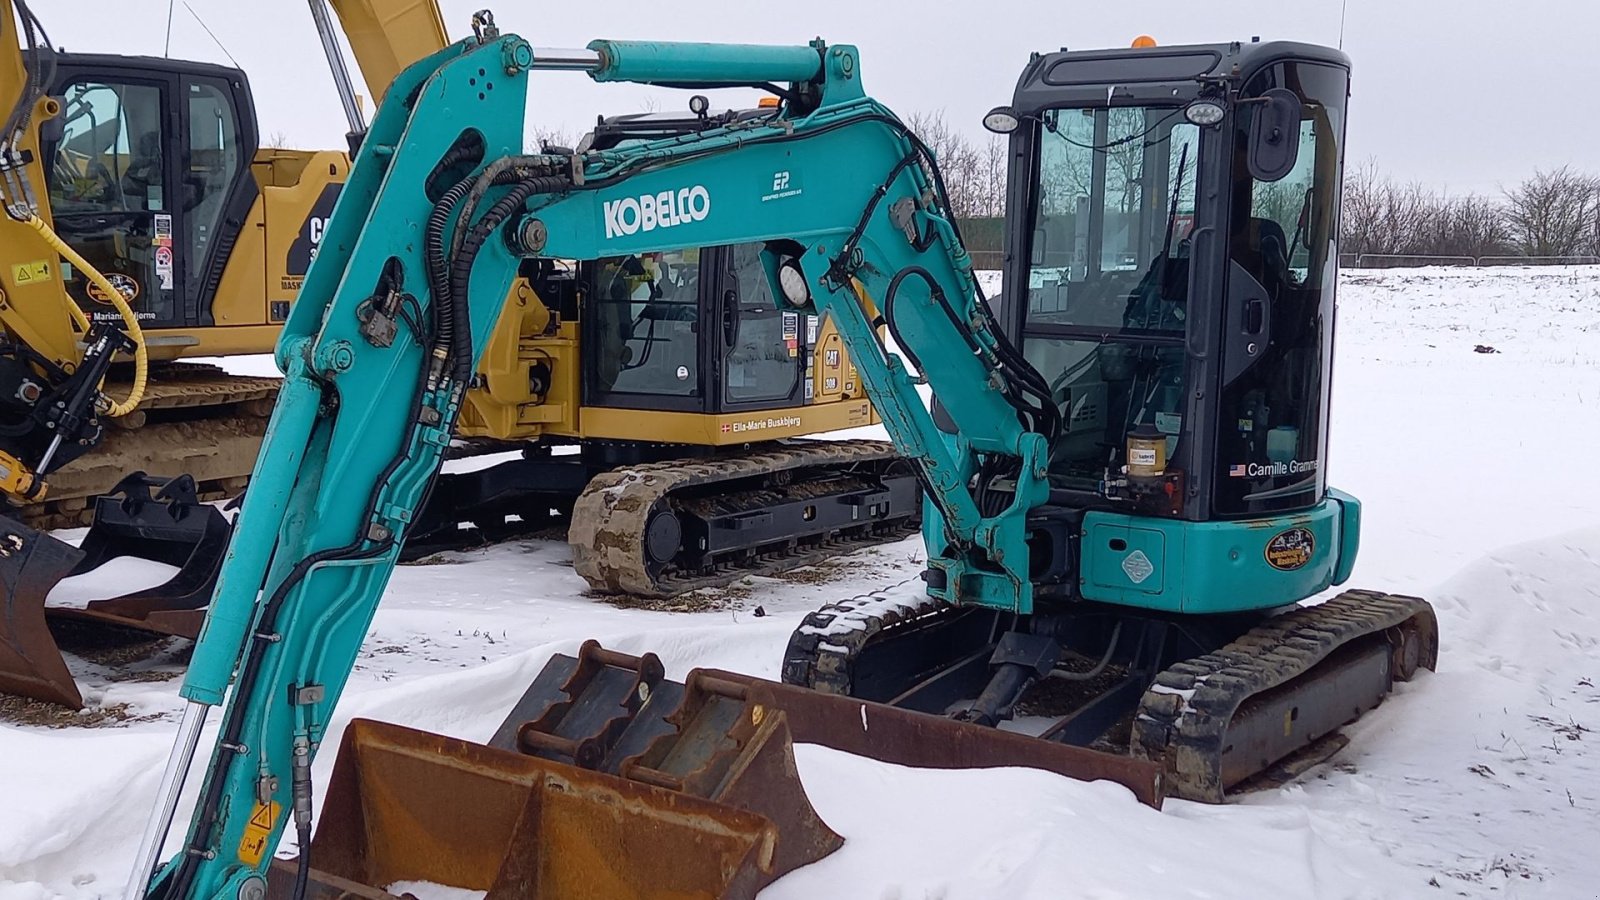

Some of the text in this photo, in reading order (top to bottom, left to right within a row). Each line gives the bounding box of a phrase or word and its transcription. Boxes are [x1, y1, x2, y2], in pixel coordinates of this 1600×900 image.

[603, 185, 711, 239] KOBELCO
[825, 350, 838, 366] CAT
[733, 415, 801, 432] Ella-Marie Buskbjerg
[1248, 459, 1319, 476] Camille Gramme
